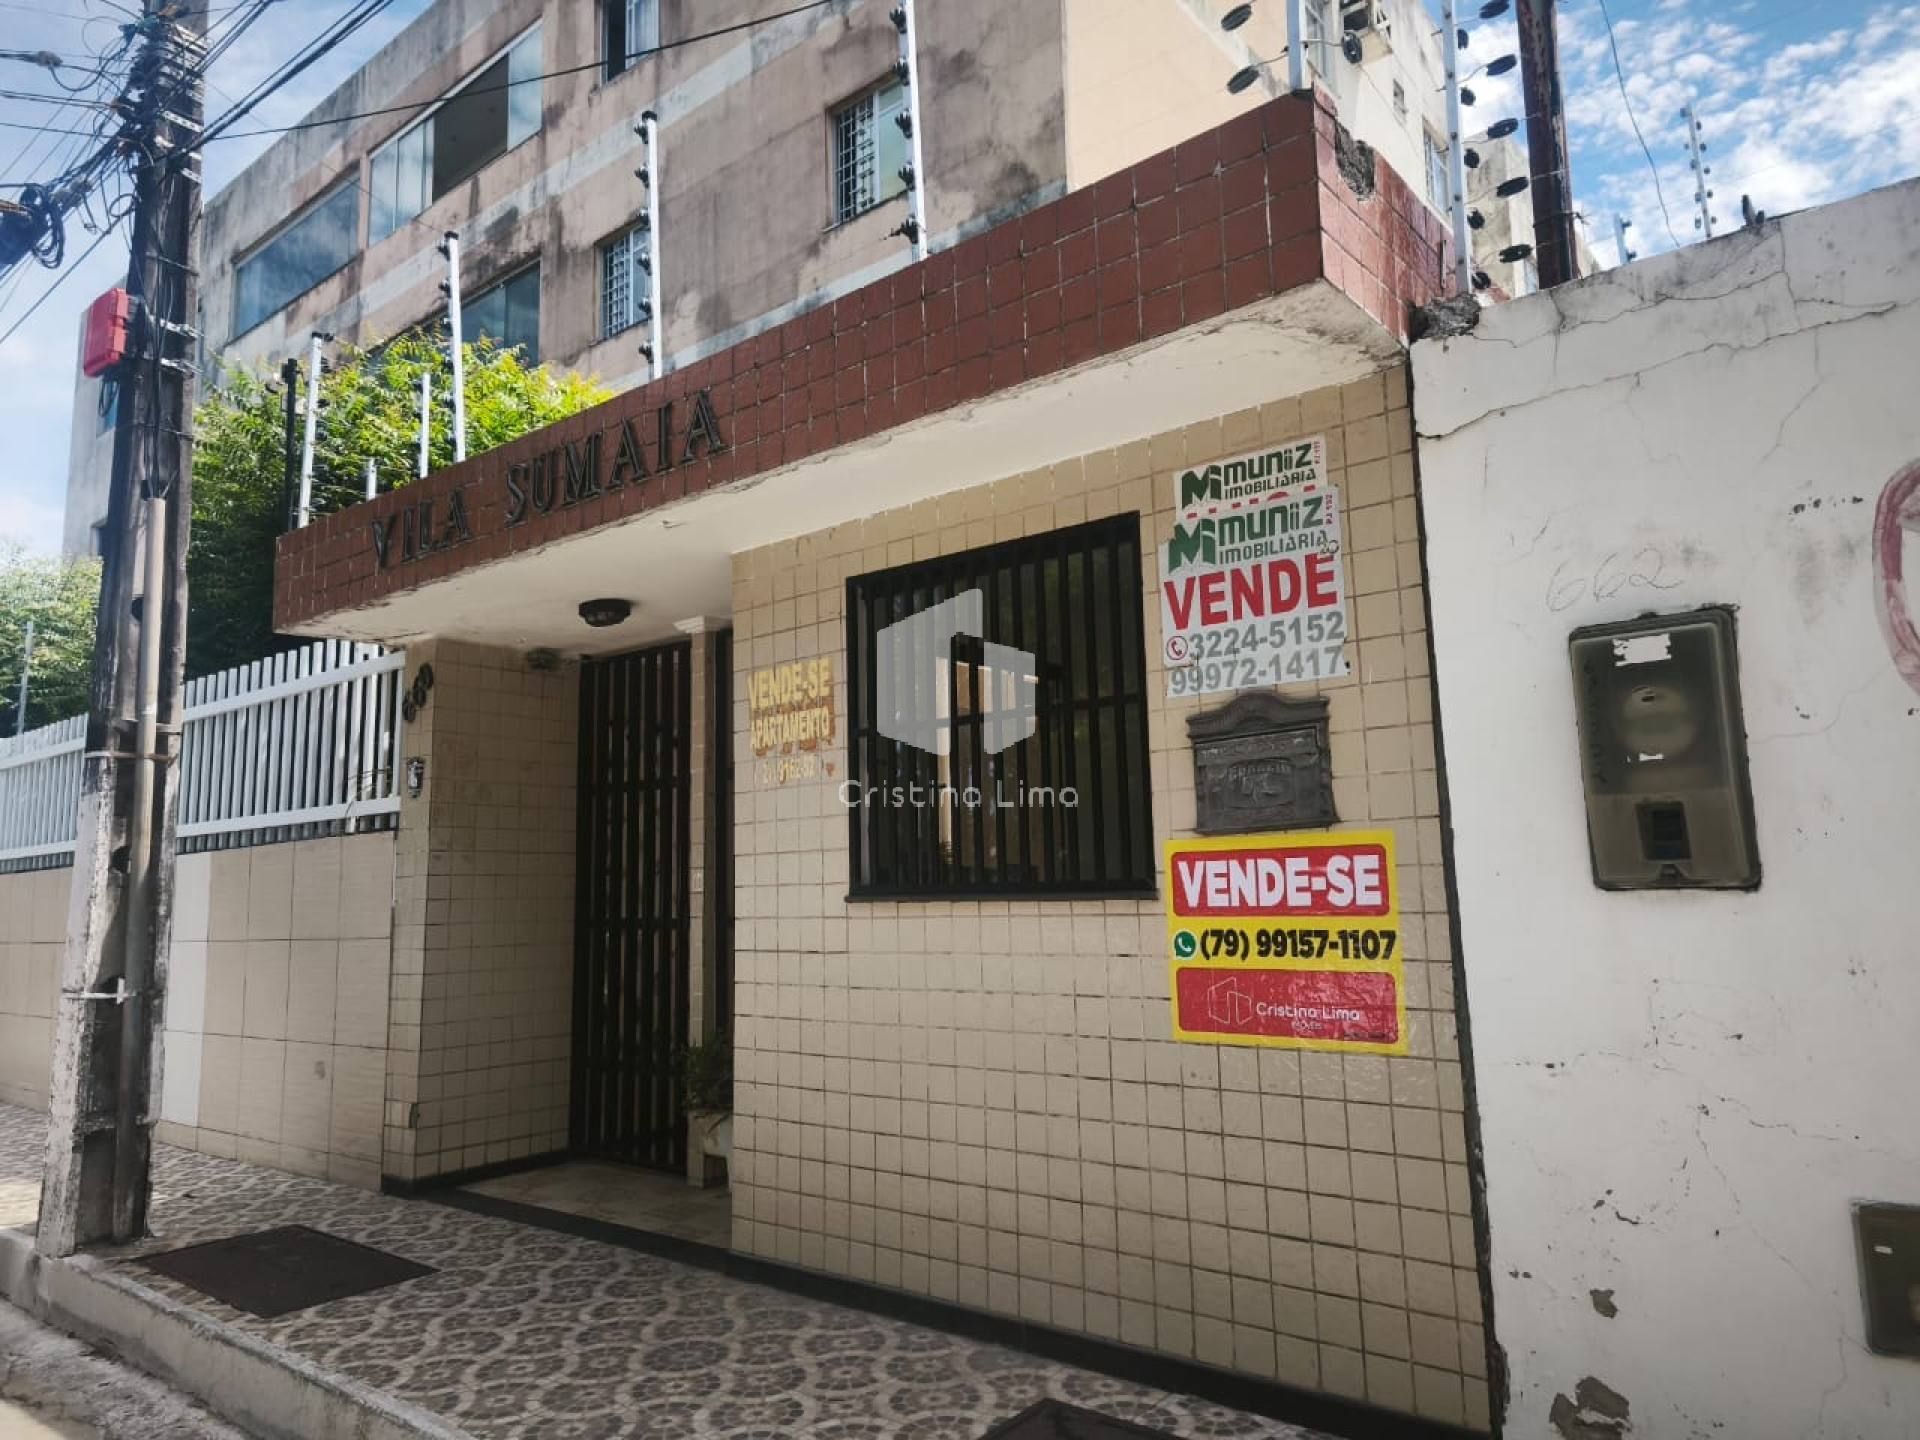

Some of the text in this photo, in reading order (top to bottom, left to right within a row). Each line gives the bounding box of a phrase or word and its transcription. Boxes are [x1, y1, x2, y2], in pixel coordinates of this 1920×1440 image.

[371, 390, 729, 569] VILA SUMAIA
[1164, 553, 1338, 631] VENDE
[1189, 611, 1344, 661] 3224-5152
[747, 656, 831, 712] VENDE-SE
[1171, 645, 1343, 694] 99972-1417
[1177, 854, 1383, 908] VENDE-SE
[1201, 928, 1396, 962] (79) 99157-1107
[1256, 1001, 1360, 1021] Cristina Lima
